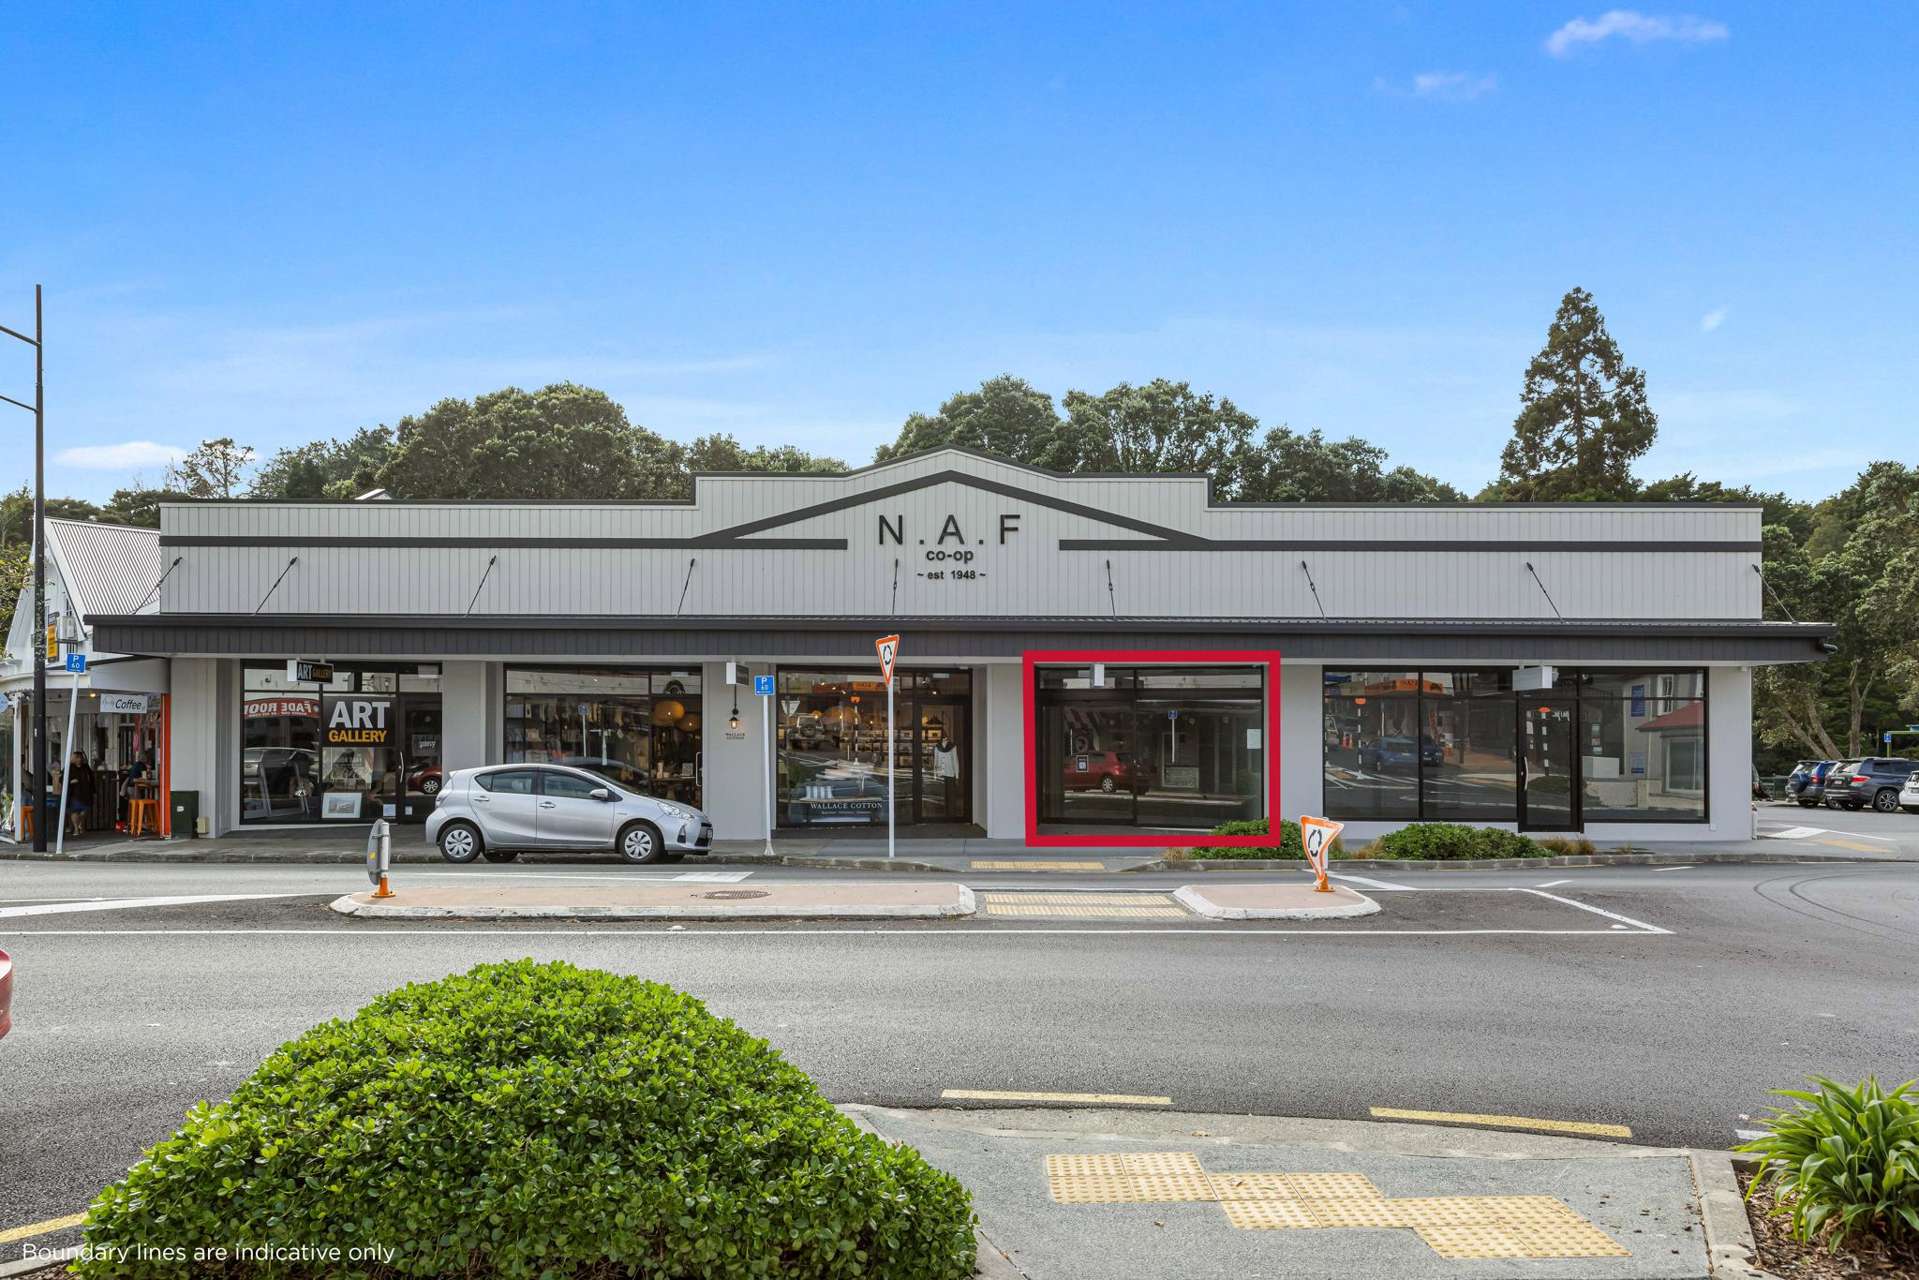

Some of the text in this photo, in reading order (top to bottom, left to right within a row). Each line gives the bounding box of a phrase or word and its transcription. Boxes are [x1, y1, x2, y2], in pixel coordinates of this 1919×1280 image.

[926, 550, 974, 564] co-op
[297, 663, 312, 680] ART
[115, 699, 142, 710] Coffee
[328, 701, 391, 729] ART
[328, 729, 387, 743] GALLERY
